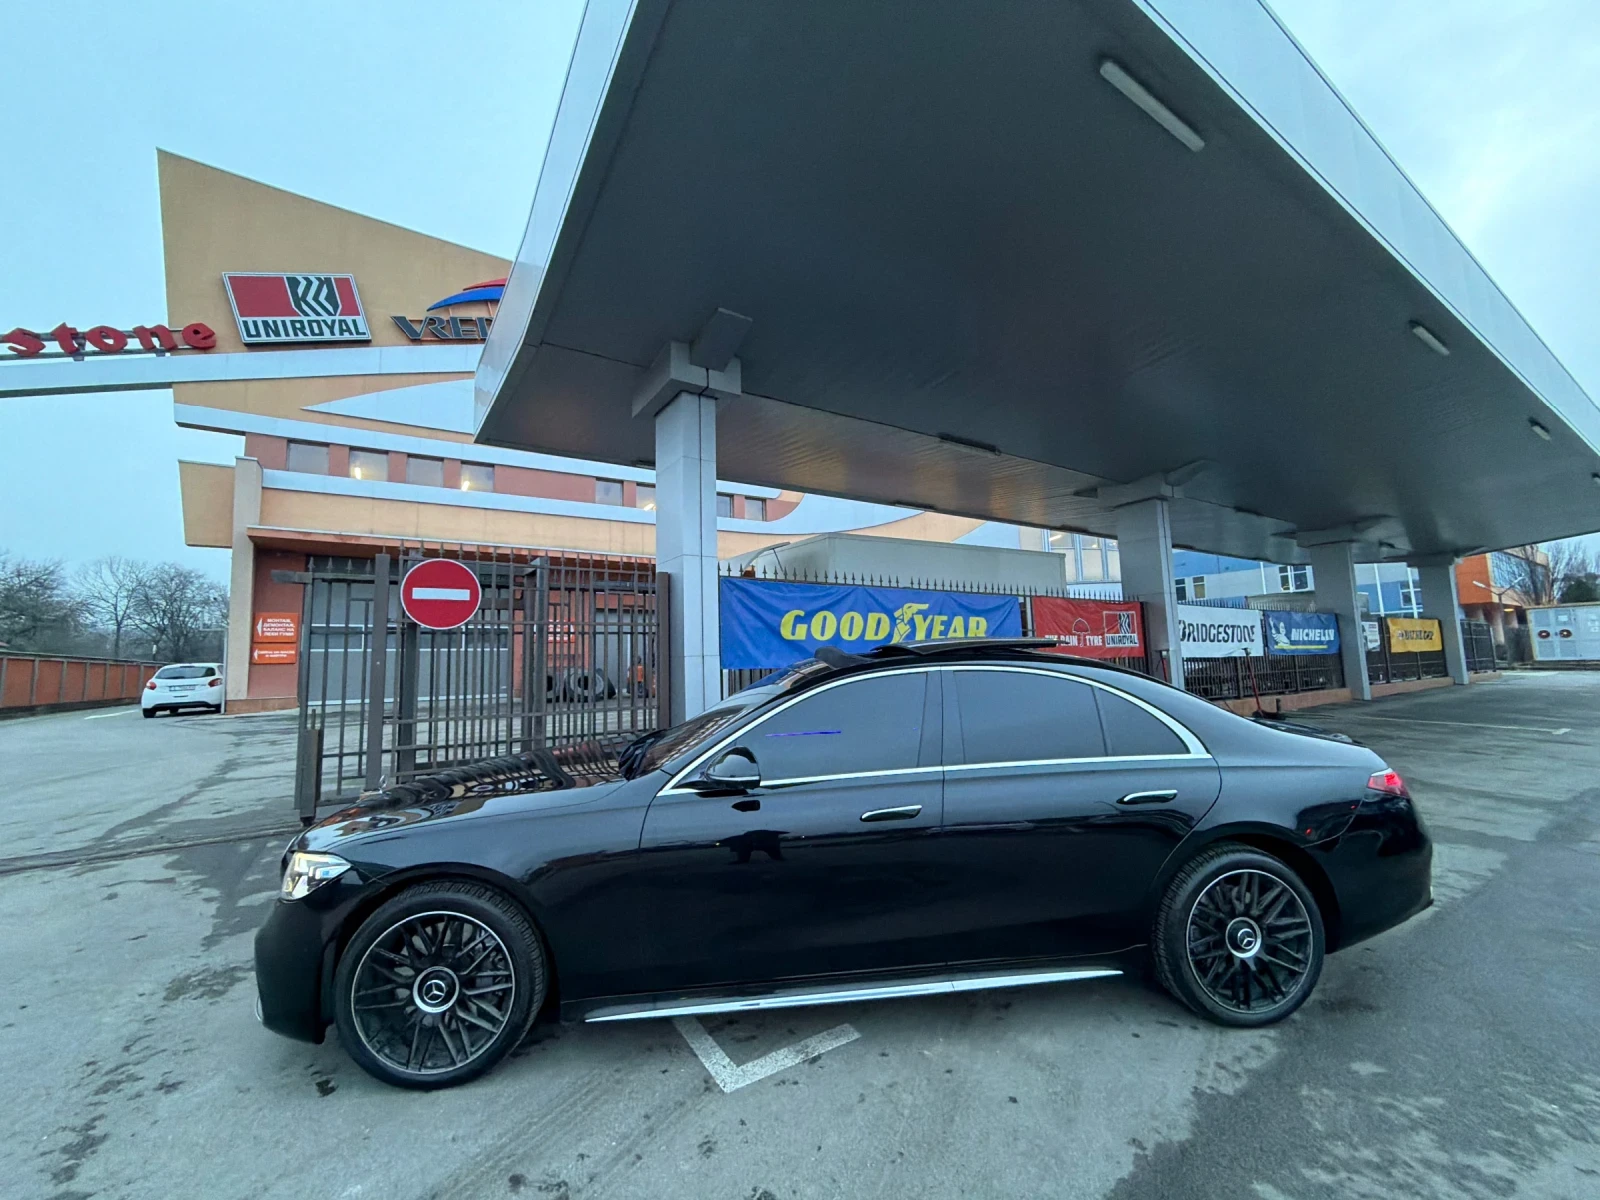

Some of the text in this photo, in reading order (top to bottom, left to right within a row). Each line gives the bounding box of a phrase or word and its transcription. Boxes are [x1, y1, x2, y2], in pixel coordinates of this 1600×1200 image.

[241, 318, 367, 338] UNIROYAL
[1086, 635, 1103, 647] TYRE
[1105, 635, 1138, 646] UNIROYAL
